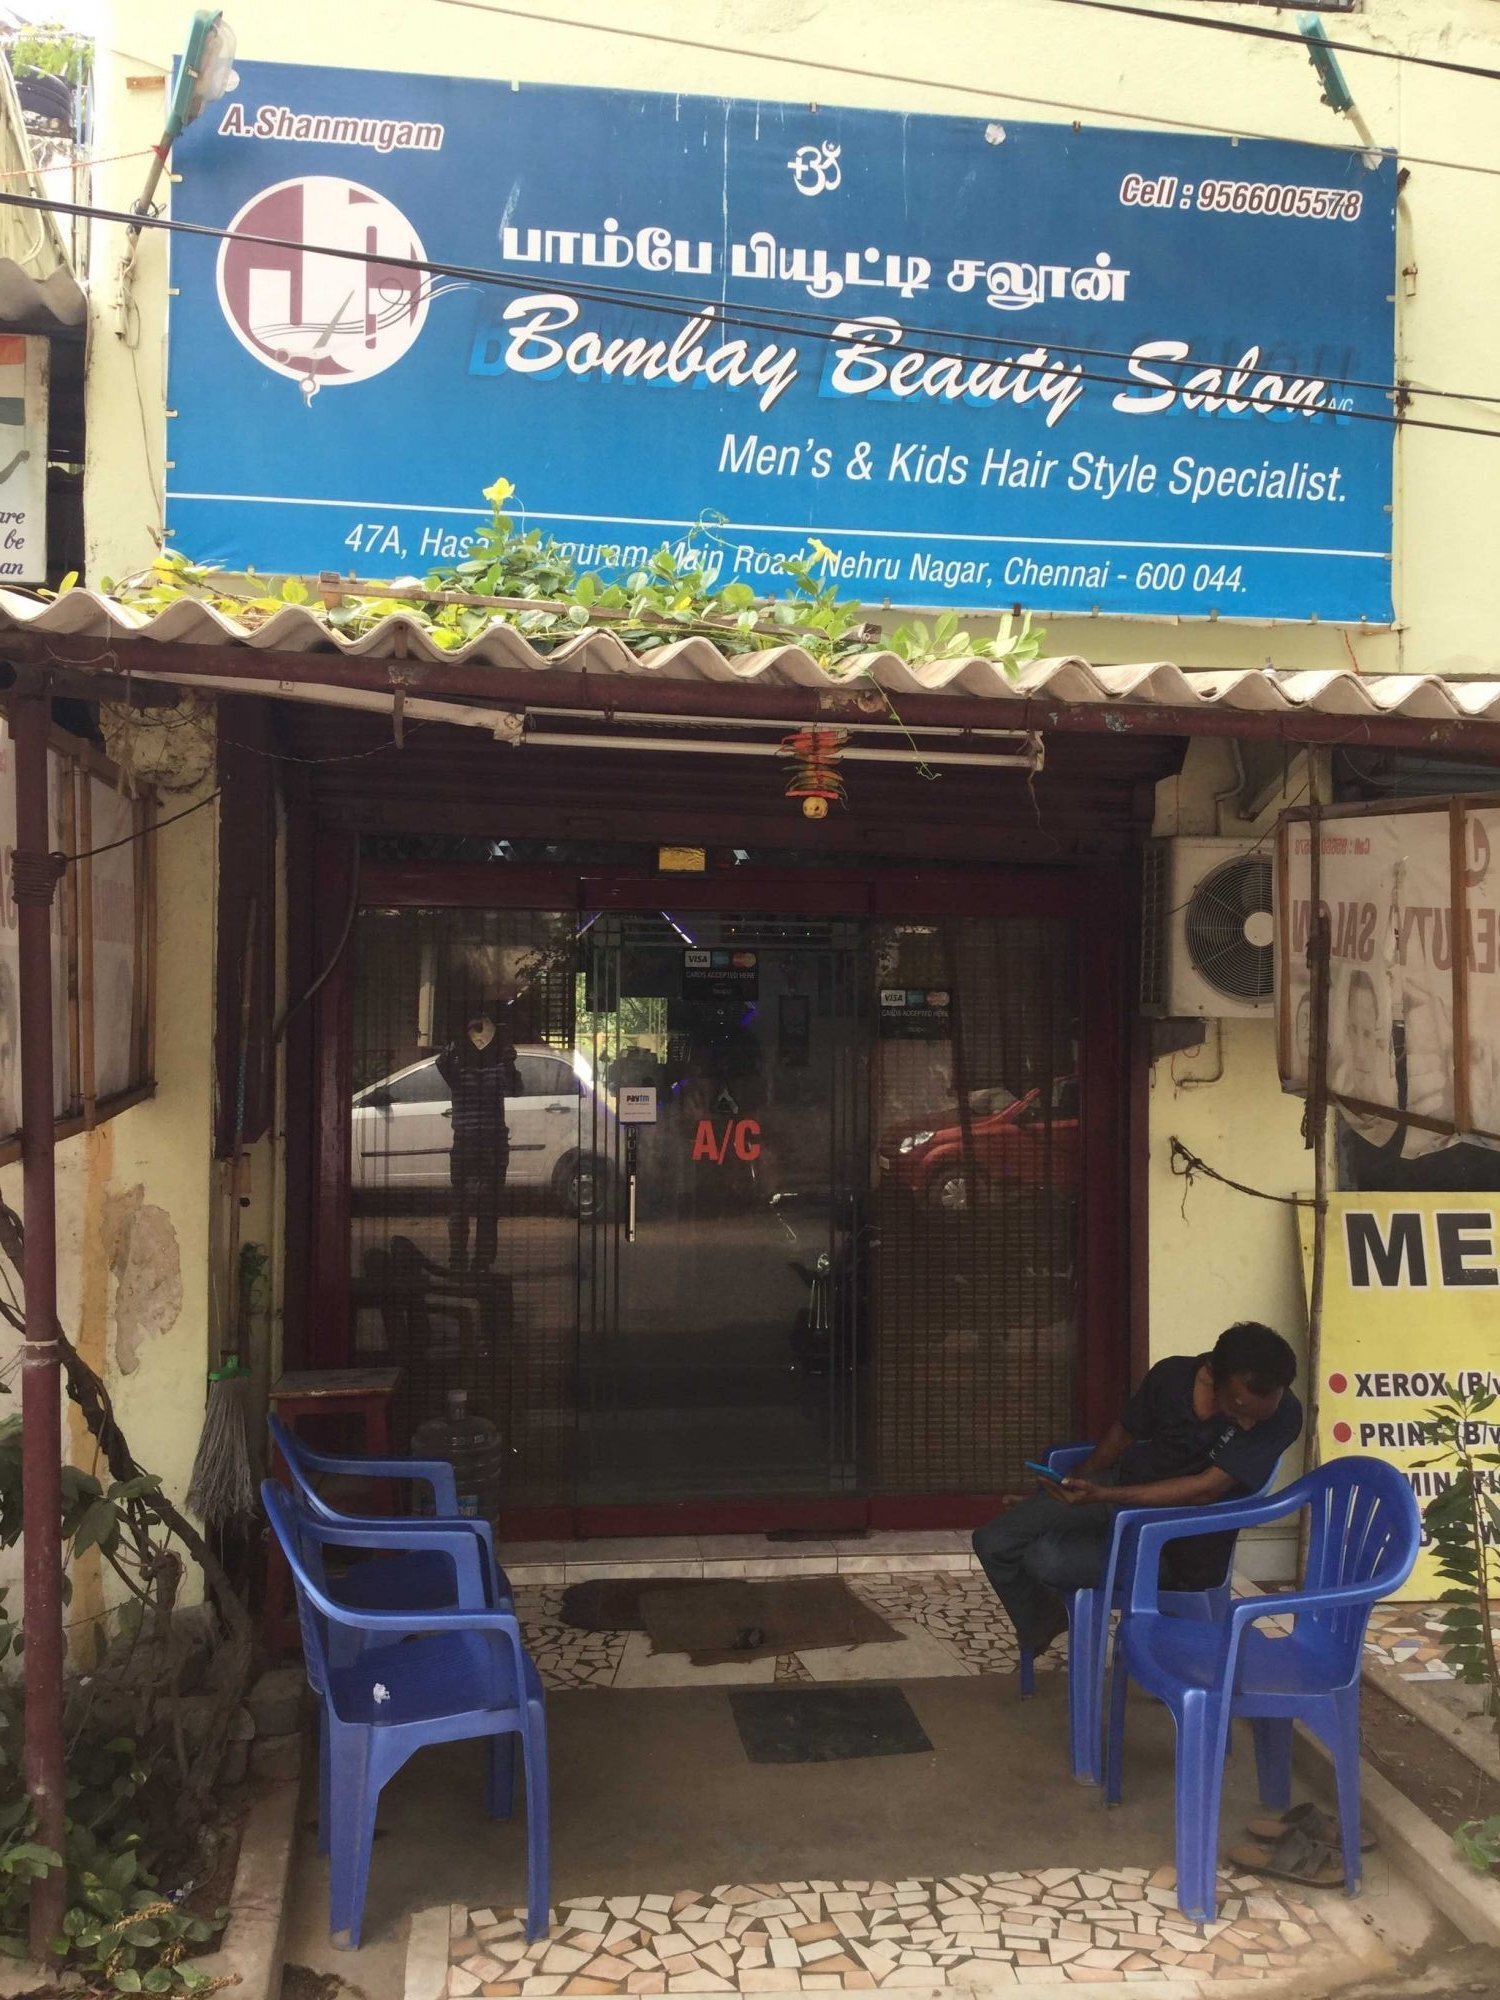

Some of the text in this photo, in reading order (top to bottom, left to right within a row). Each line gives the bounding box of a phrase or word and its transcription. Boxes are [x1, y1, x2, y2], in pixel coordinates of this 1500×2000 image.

[219, 104, 444, 152] A.Shanmugam
[1121, 174, 1177, 207] Cell
[1198, 180, 1362, 222] 9566005578
[503, 217, 1131, 311] பாம்பே பியூட்டி சலூன்
[503, 294, 797, 412] Bombay
[831, 316, 1083, 428] Beauty
[1112, 341, 1326, 417] Salon
[718, 433, 1346, 504] Men's & Kids Hair Style Specialist.
[4, 529, 25, 549] be
[345, 524, 407, 559] 47A,
[820, 550, 901, 580] Nehru
[909, 553, 994, 588] Nagar,
[1004, 556, 1109, 588] Chennai
[1136, 563, 1184, 590] 600
[1192, 564, 1246, 592] 044.
[688, 955, 708, 963] VISA
[885, 994, 903, 1002] VISA
[692, 1119, 761, 1165] A/C
[1345, 1212, 1499, 1287] ME
[1354, 1372, 1448, 1397] XEROX
